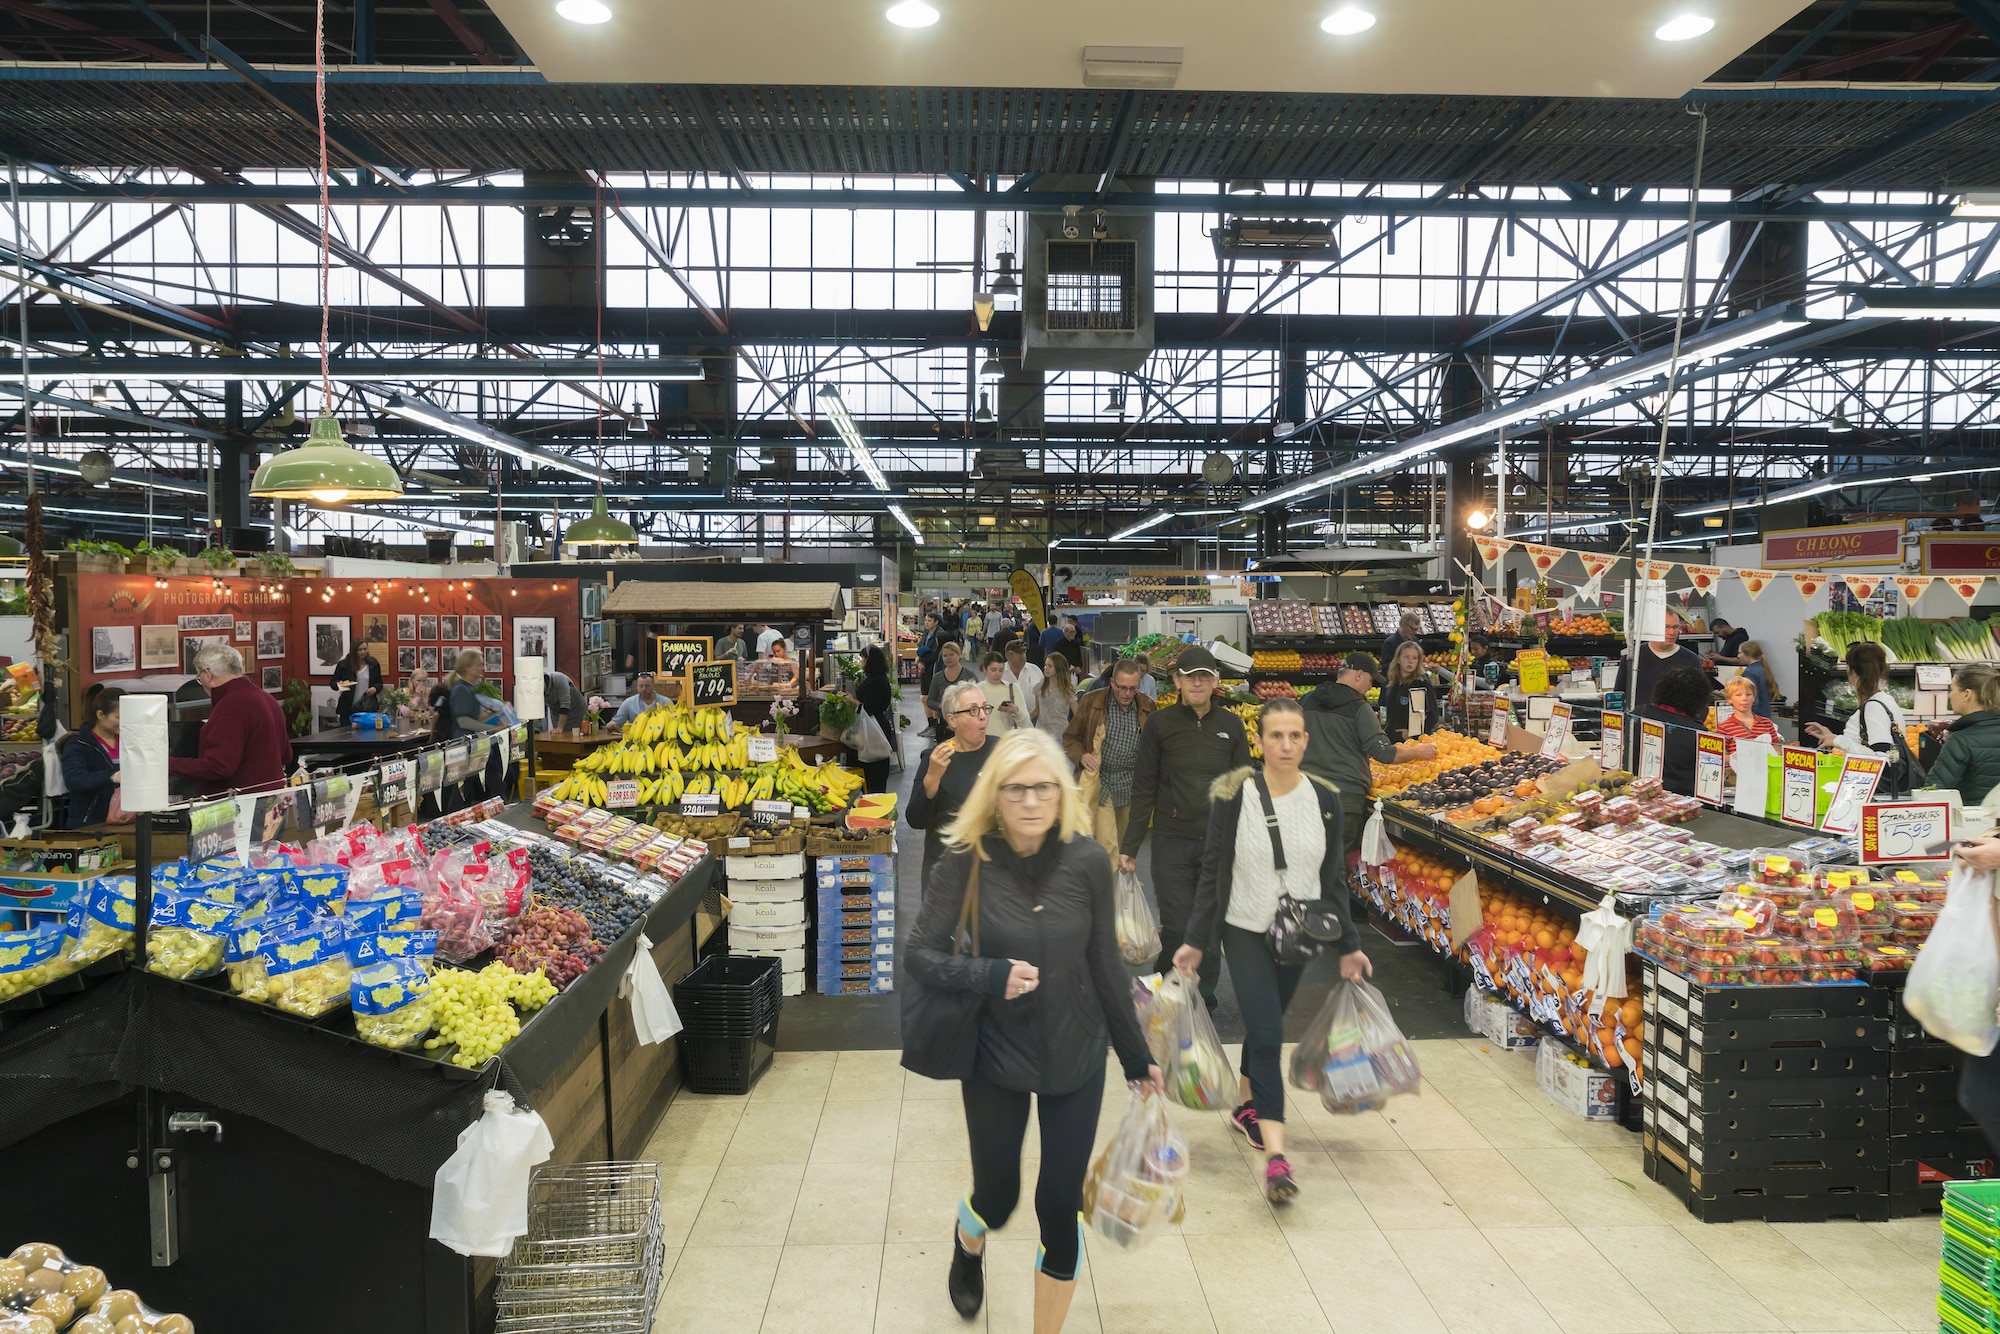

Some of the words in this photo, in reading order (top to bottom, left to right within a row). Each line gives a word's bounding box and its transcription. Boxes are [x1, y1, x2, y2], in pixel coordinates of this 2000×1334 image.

[1796, 535, 1862, 551] CHEONG
[946, 563, 962, 571] Deli
[963, 563, 988, 571] Arcade
[164, 592, 239, 604] PHOTOGRAPHIC
[662, 642, 703, 653] BANANAS
[1700, 737, 1723, 752] SPECIAL
[1785, 751, 1815, 769] SPECIAL
[1847, 759, 1860, 770] SALE
[388, 763, 406, 775] BLACK
[613, 791, 622, 800] FOR
[1864, 833, 1877, 851] SAVE
[31, 852, 73, 860] CALIFORNIA
[754, 861, 775, 869] Koala
[755, 884, 776, 892] Koala
[755, 908, 777, 916] Koala
[755, 932, 777, 940] Koala
